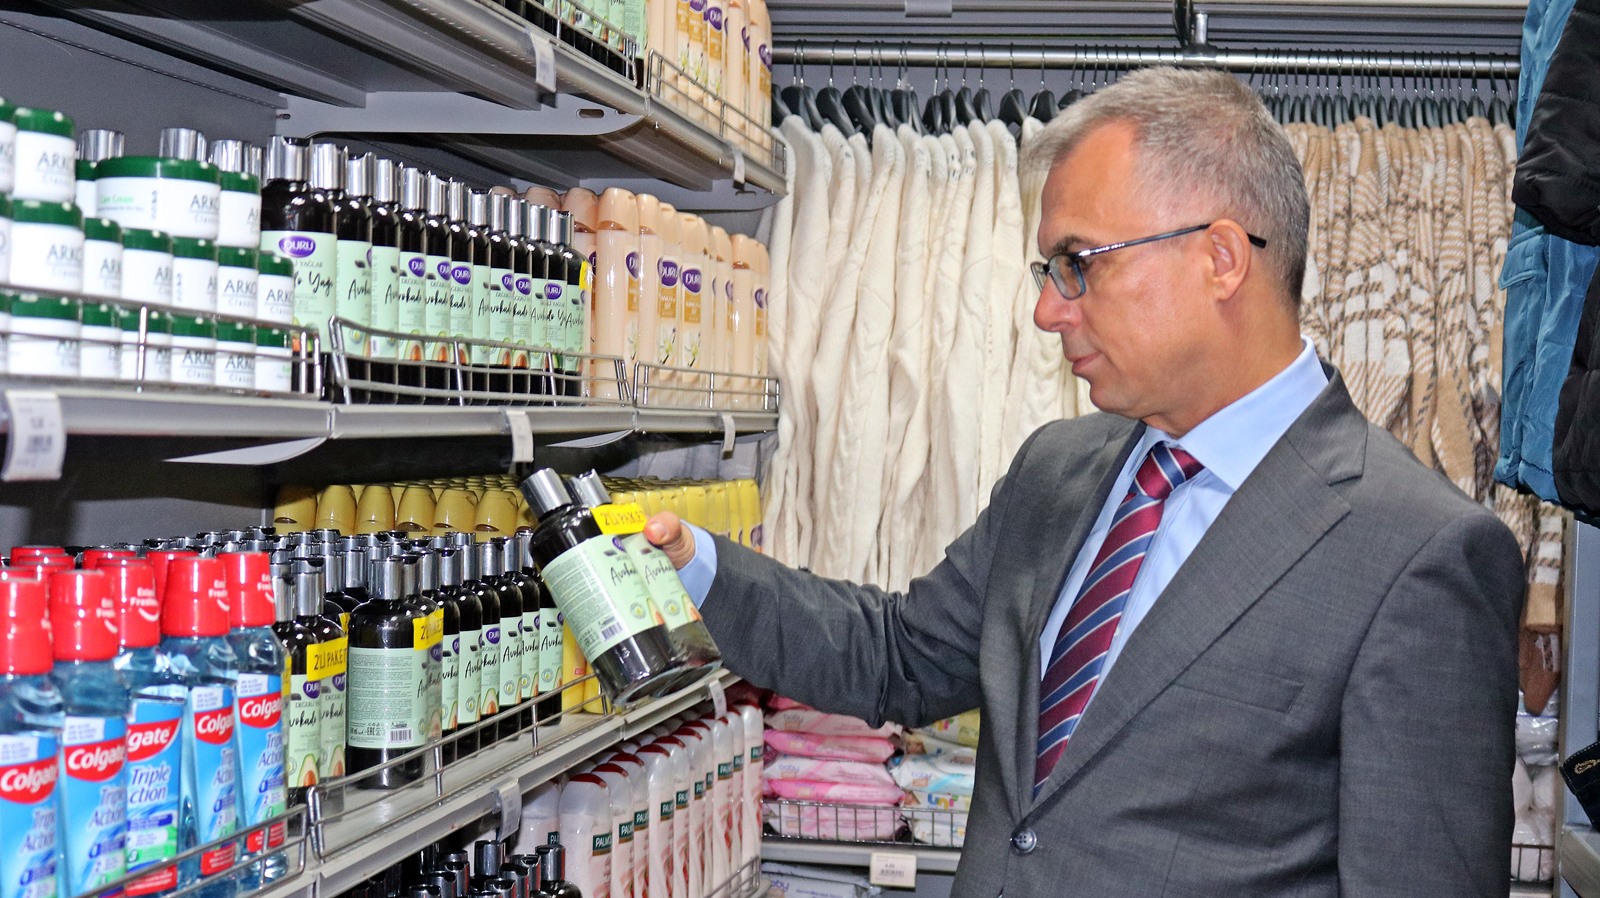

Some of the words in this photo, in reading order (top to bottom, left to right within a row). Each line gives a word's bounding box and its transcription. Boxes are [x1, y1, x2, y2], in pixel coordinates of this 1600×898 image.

[284, 239, 314, 251] DURU
[289, 710, 317, 728] vokado
[127, 727, 171, 753] lgate
[132, 765, 171, 787] Triple
[129, 786, 167, 805] ction
